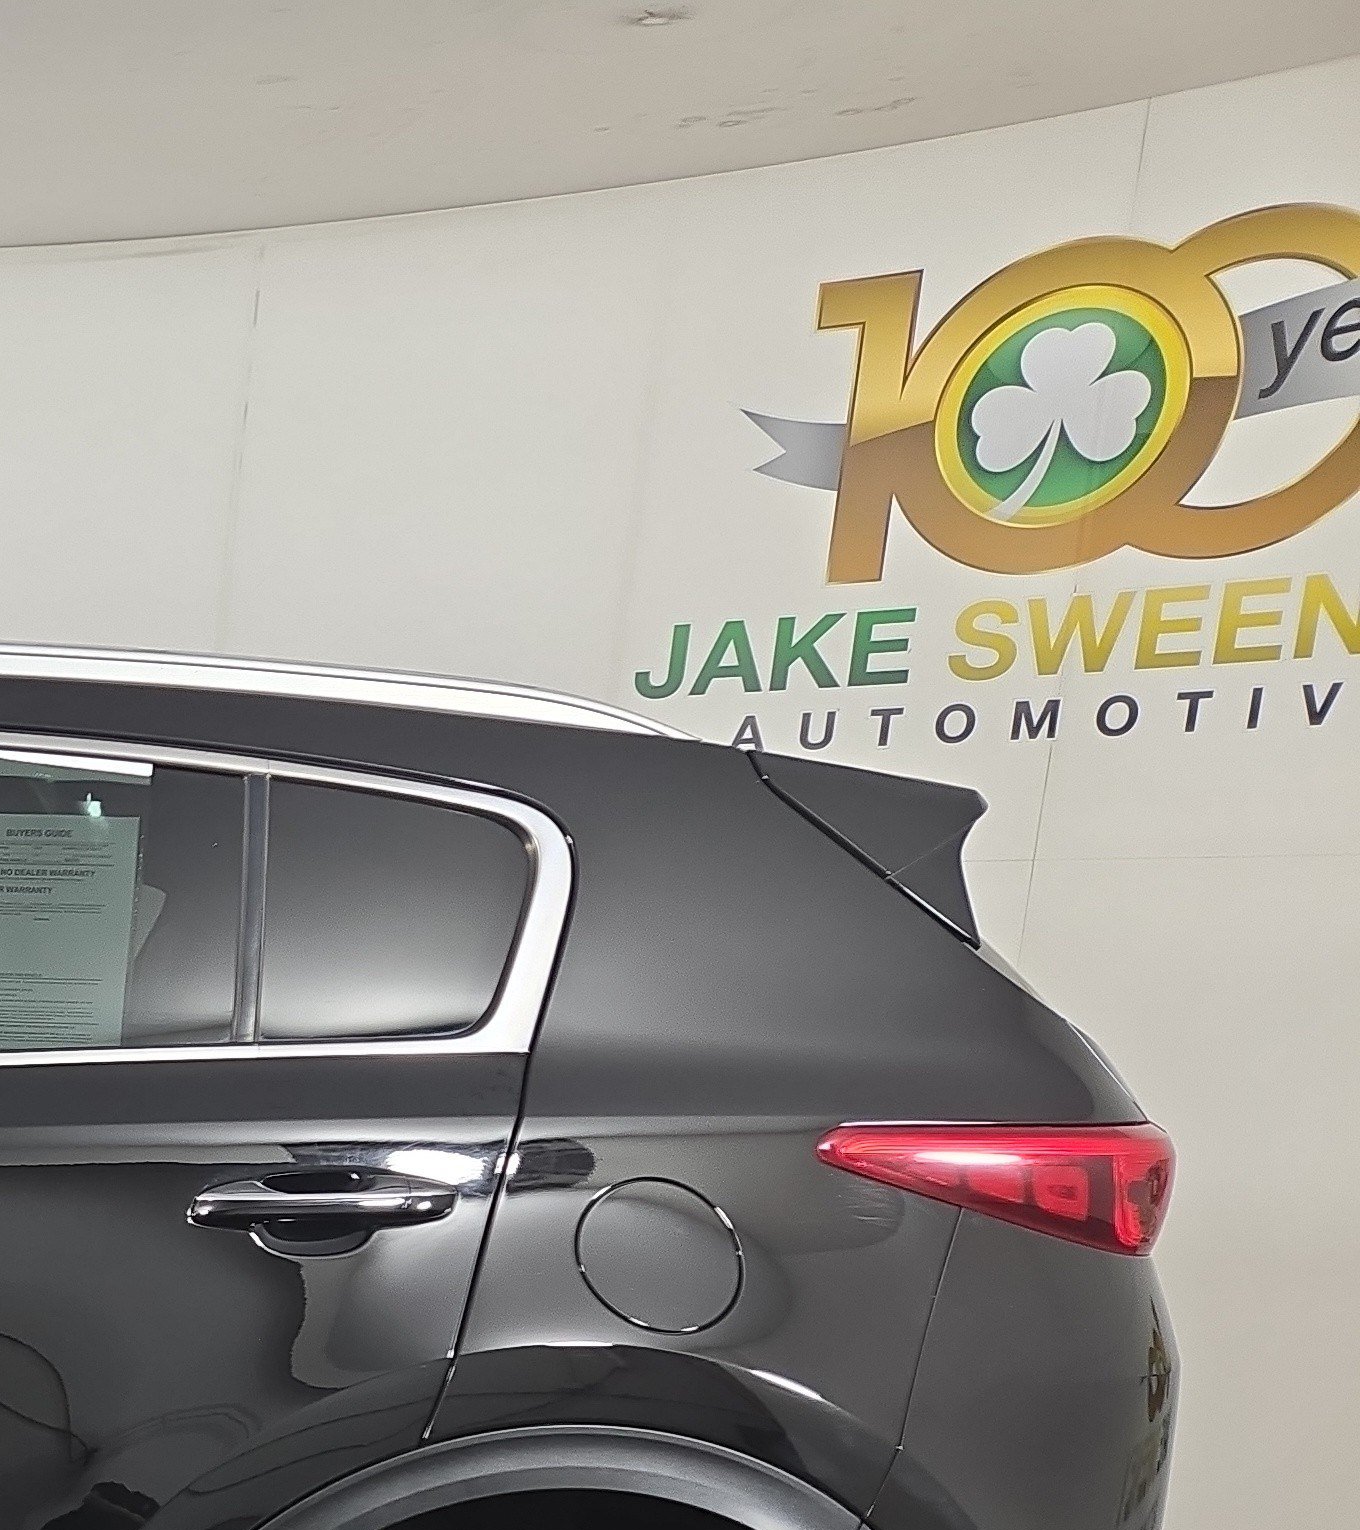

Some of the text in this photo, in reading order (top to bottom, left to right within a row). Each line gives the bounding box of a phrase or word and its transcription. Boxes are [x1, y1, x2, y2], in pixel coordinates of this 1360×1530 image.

[1258, 296, 1360, 400] ye
[633, 572, 1360, 700] JAKE SWEEN
[731, 681, 1345, 753] AUTOMOTIV
[6, 829, 74, 839] BUYERS GUIDE
[0, 868, 13, 876] NO
[14, 868, 48, 877] DEALER
[49, 869, 96, 878] WARRANTY
[6, 886, 53, 894] WARRANTY
